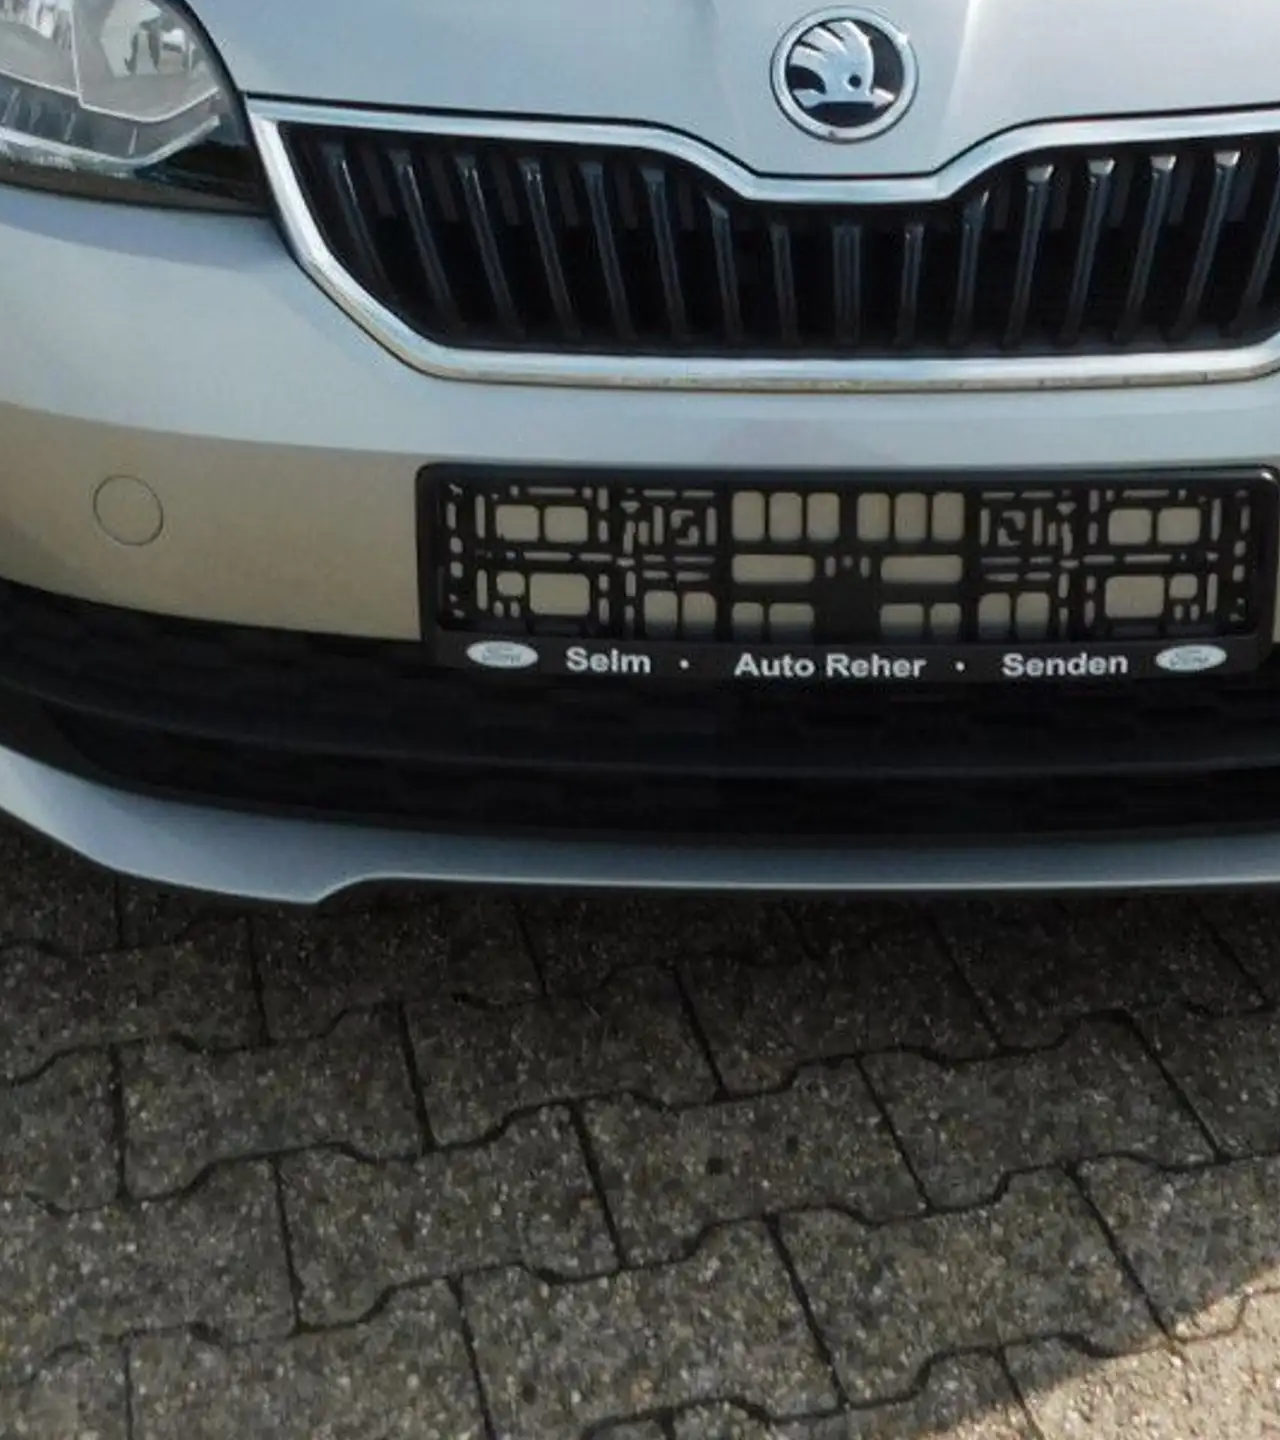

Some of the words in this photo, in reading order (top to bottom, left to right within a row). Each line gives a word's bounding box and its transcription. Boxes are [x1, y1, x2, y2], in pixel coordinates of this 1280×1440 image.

[565, 645, 652, 674] Selm
[733, 651, 816, 678] Auto
[825, 652, 927, 678] Reher
[1001, 651, 1130, 678] Senden
